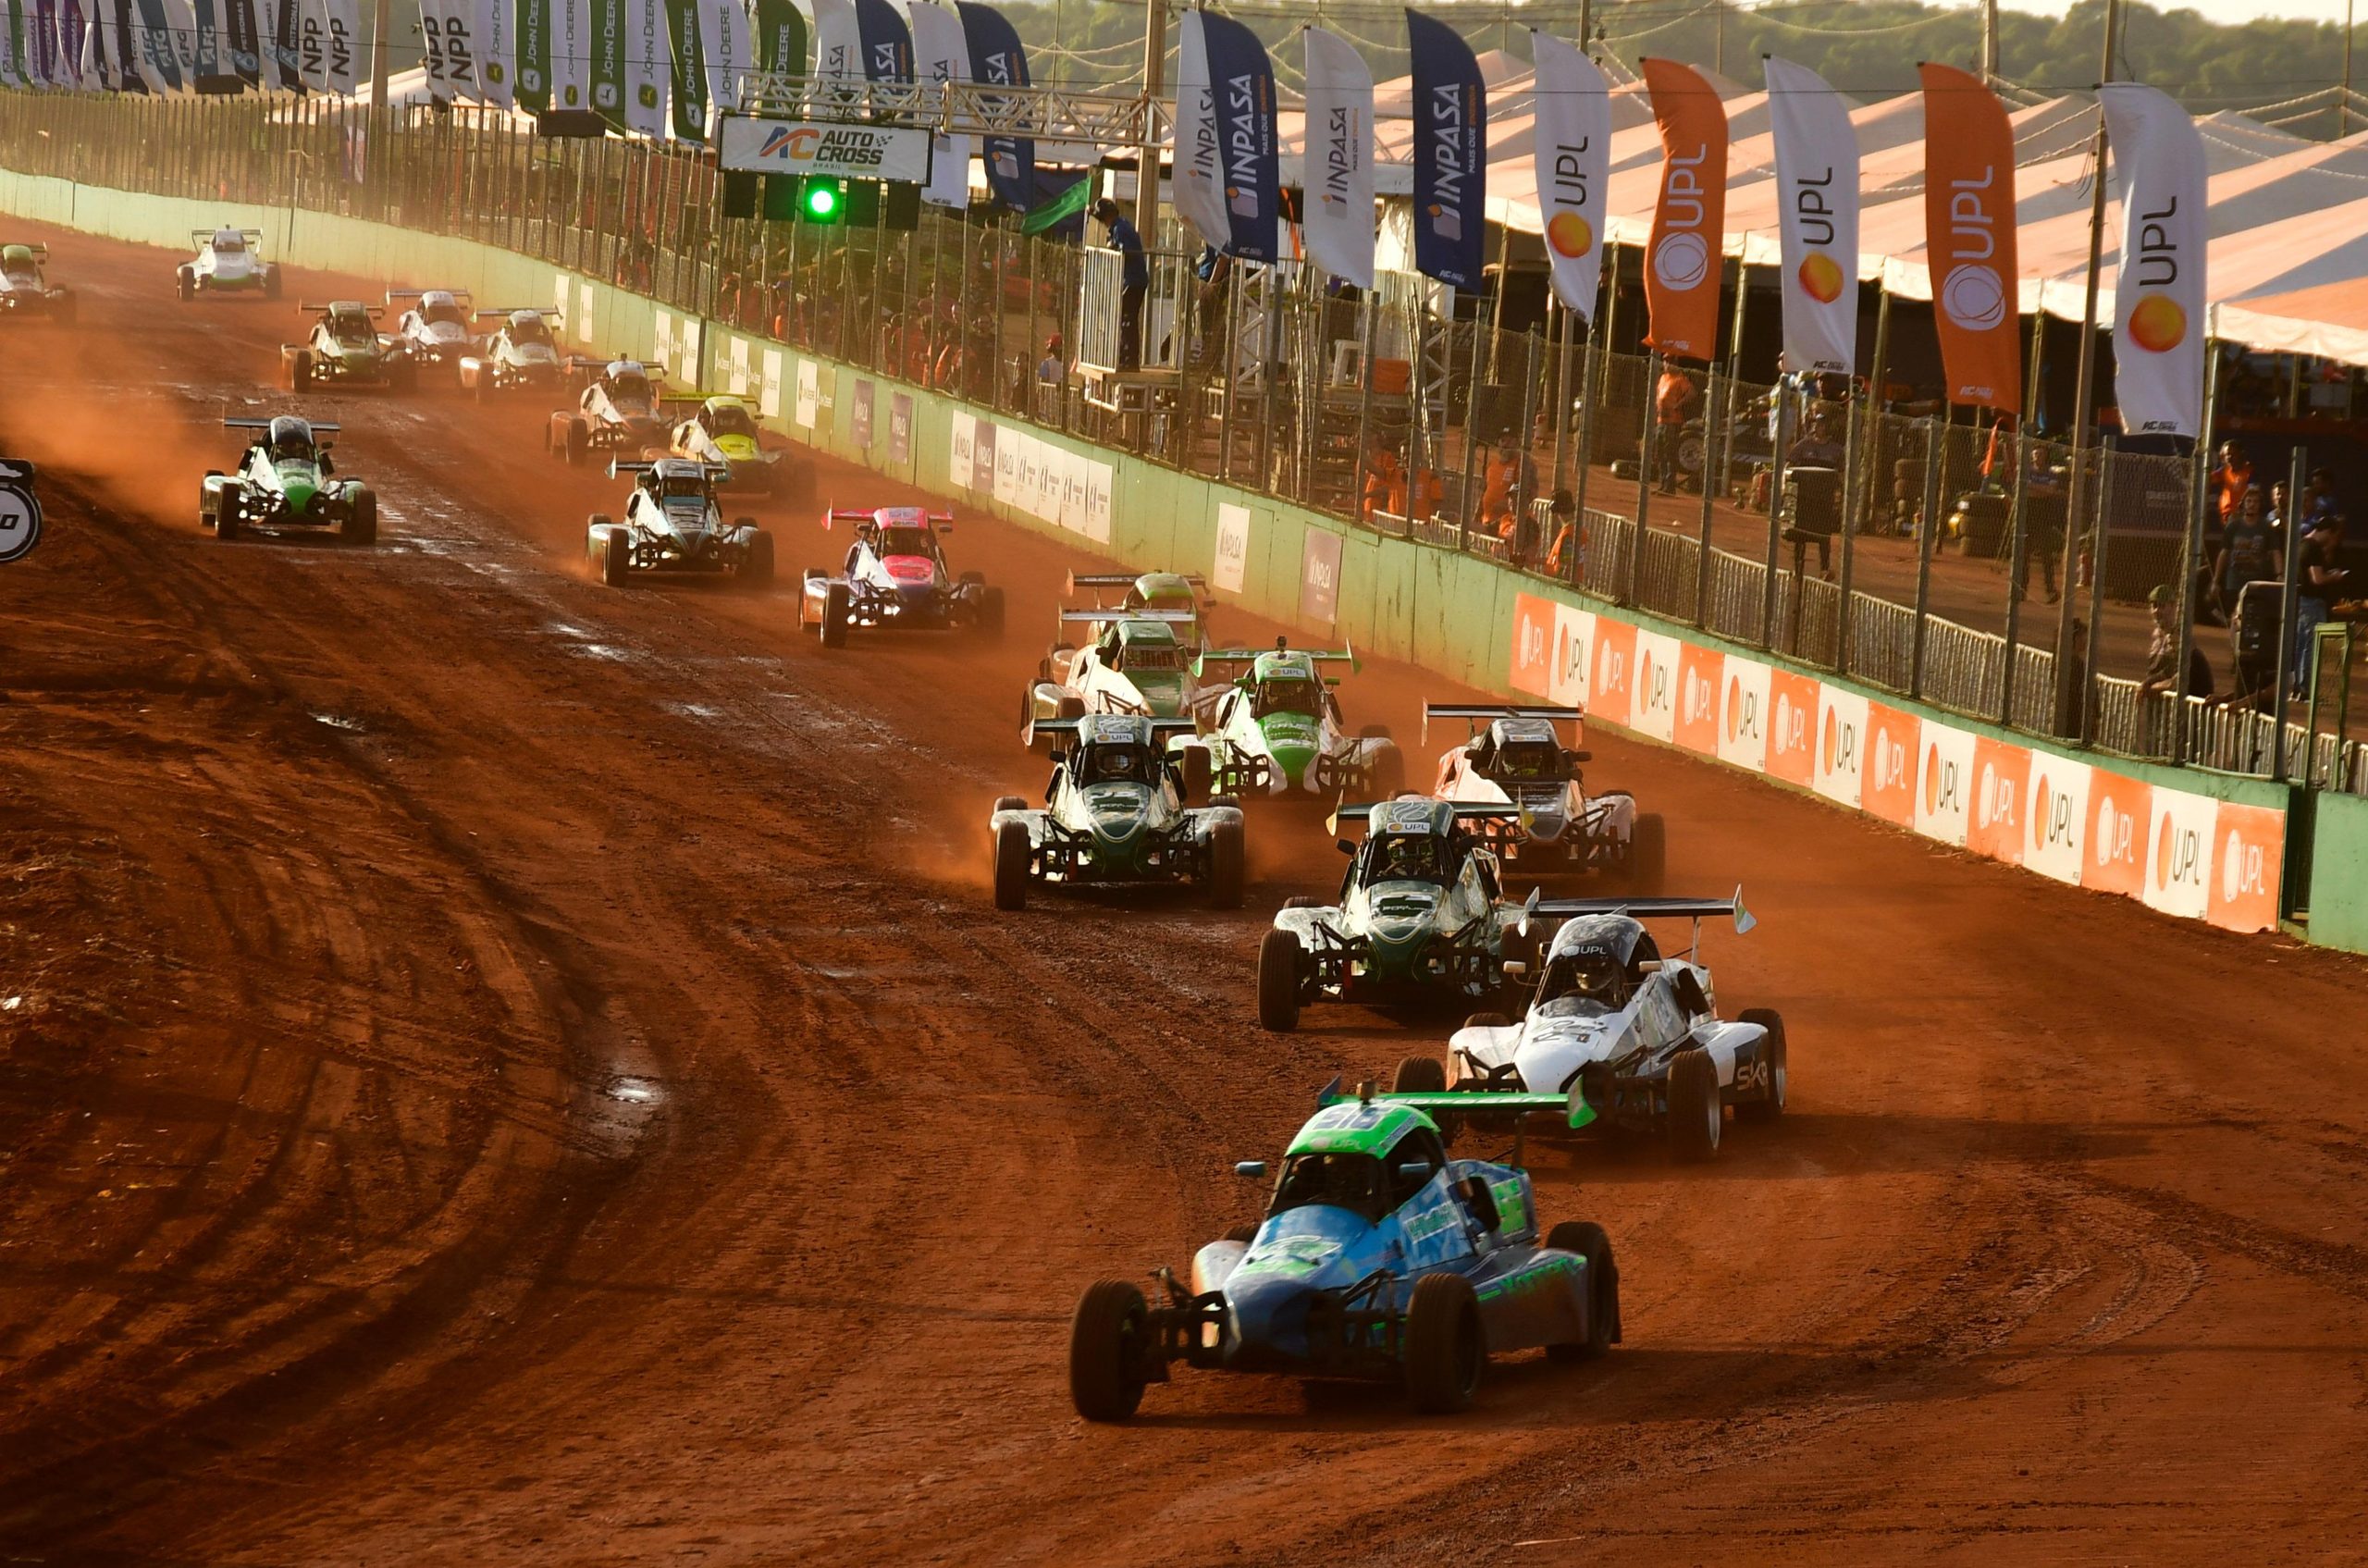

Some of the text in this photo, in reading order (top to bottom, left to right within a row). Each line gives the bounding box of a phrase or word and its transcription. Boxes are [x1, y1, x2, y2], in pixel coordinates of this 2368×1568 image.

[303, 18, 323, 74] NPP
[330, 18, 351, 76] NPP
[424, 16, 445, 80] NPP
[446, 16, 473, 82] NPP
[490, 24, 501, 57] JOHN
[526, 29, 537, 65] JOHN
[566, 43, 574, 79] JOHN
[602, 0, 616, 79] JOHN DEER
[643, 0, 655, 79] JOHN DEER
[683, 7, 696, 98] JOHN DEERE
[720, 5, 732, 99] JOHN DEERE
[775, 24, 790, 75] DEERE
[759, 127, 820, 160] AC
[821, 130, 875, 147] AUTO
[1228, 74, 1260, 183] INPASA
[1326, 106, 1351, 189] INPASA
[1434, 83, 1466, 204] INPASA
[1468, 127, 1477, 147] QUE
[816, 146, 884, 165] CROSS
[1468, 148, 1477, 174] MAIS
[1555, 136, 1588, 205] UPL
[1666, 143, 1706, 228] UPL
[1796, 167, 1834, 245] UPL
[1952, 166, 1994, 259] UPL
[2139, 196, 2177, 287] UPL
[1528, 623, 1544, 666] UPL
[1567, 638, 1585, 682] UPL
[1608, 650, 1624, 692] UPL
[1651, 663, 1668, 710] UPL
[1695, 675, 1711, 722] UPL
[1739, 691, 1758, 739] UPL
[1787, 706, 1807, 751] UPL
[1835, 721, 1856, 773] UPL
[1887, 741, 1906, 790] UPL
[1939, 759, 1959, 813] UPL
[1992, 778, 2015, 826] UPL
[2048, 791, 2073, 847] UPL
[2112, 812, 2134, 863] UPL
[2173, 830, 2201, 885] UPL
[2239, 845, 2264, 895] UPL
[1580, 945, 1607, 955] UPL
[1333, 1139, 1361, 1149] UPL
